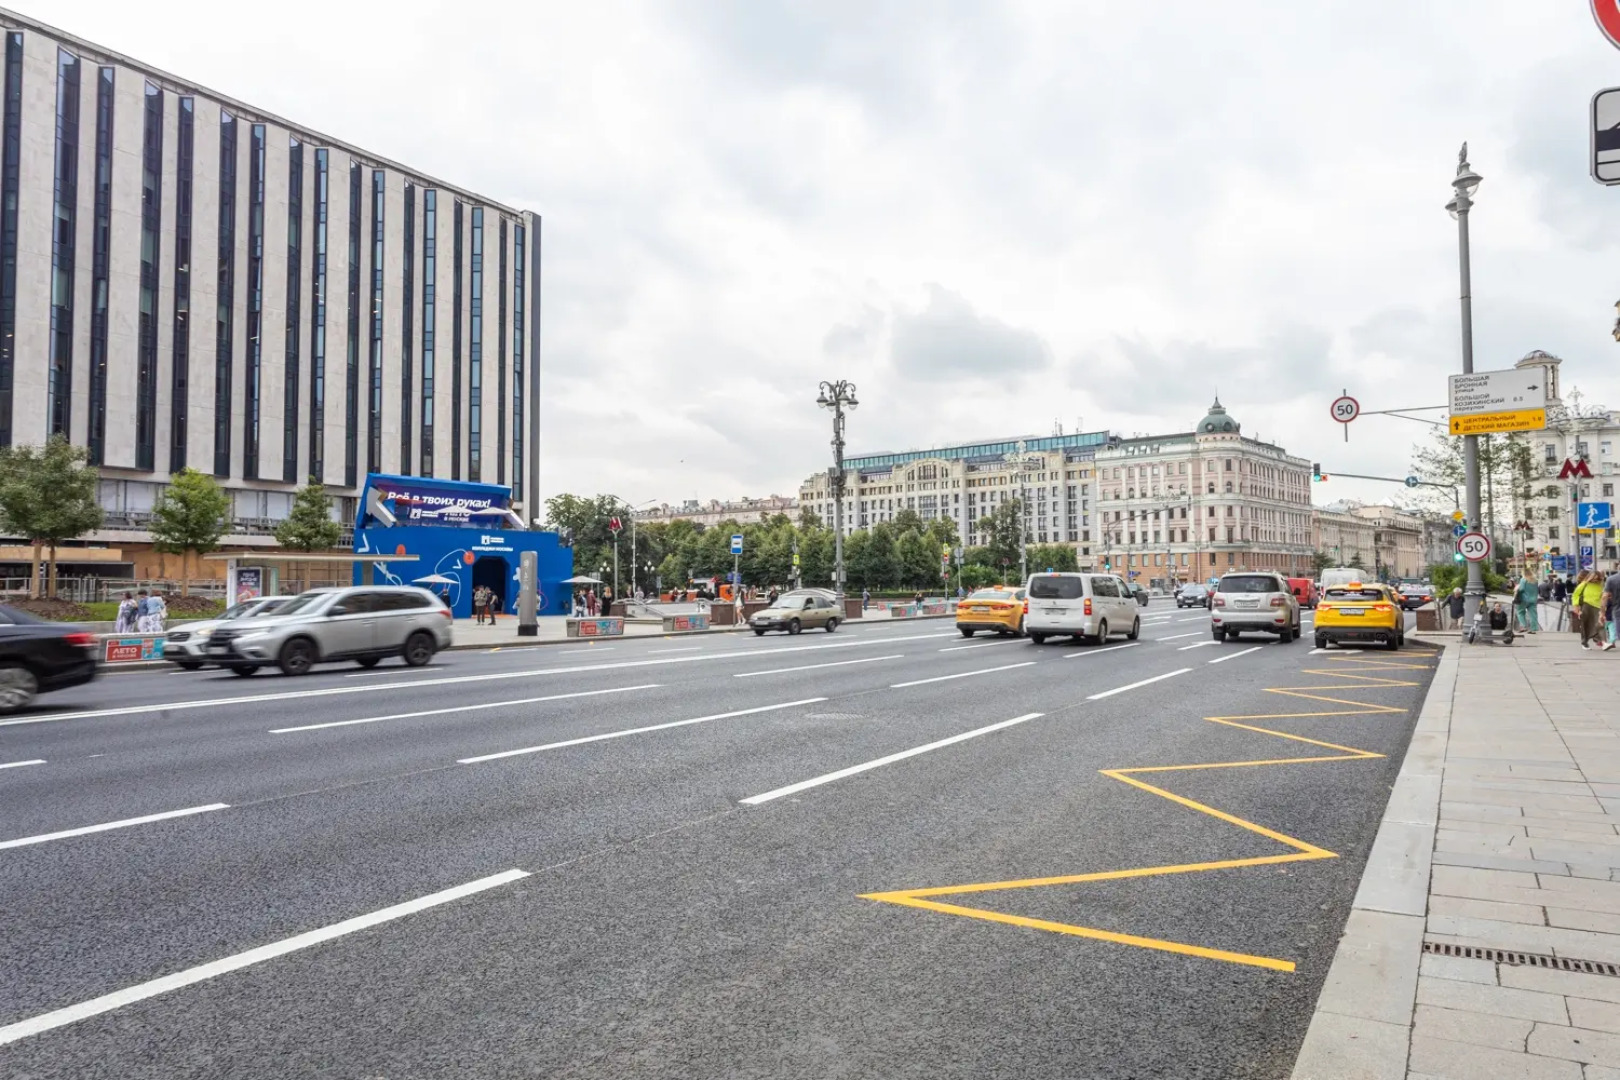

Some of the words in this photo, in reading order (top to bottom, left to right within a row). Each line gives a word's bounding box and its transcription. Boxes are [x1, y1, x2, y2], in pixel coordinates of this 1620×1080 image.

[1454, 375, 1490, 383] БОЛЬШАЯ
[1454, 381, 1488, 389] БРОННАЯ
[1454, 393, 1490, 402] БОЛЬШОЙ
[1337, 404, 1353, 416] 50
[1463, 415, 1516, 424] ЦЕНТРАЛЬНЫЙ
[1463, 423, 1495, 431] ДЕТСКИЙ
[1496, 420, 1530, 429] МАГАЗИН
[422, 496, 455, 505] твоих
[456, 498, 491, 508] руках!
[1465, 541, 1483, 553] 50
